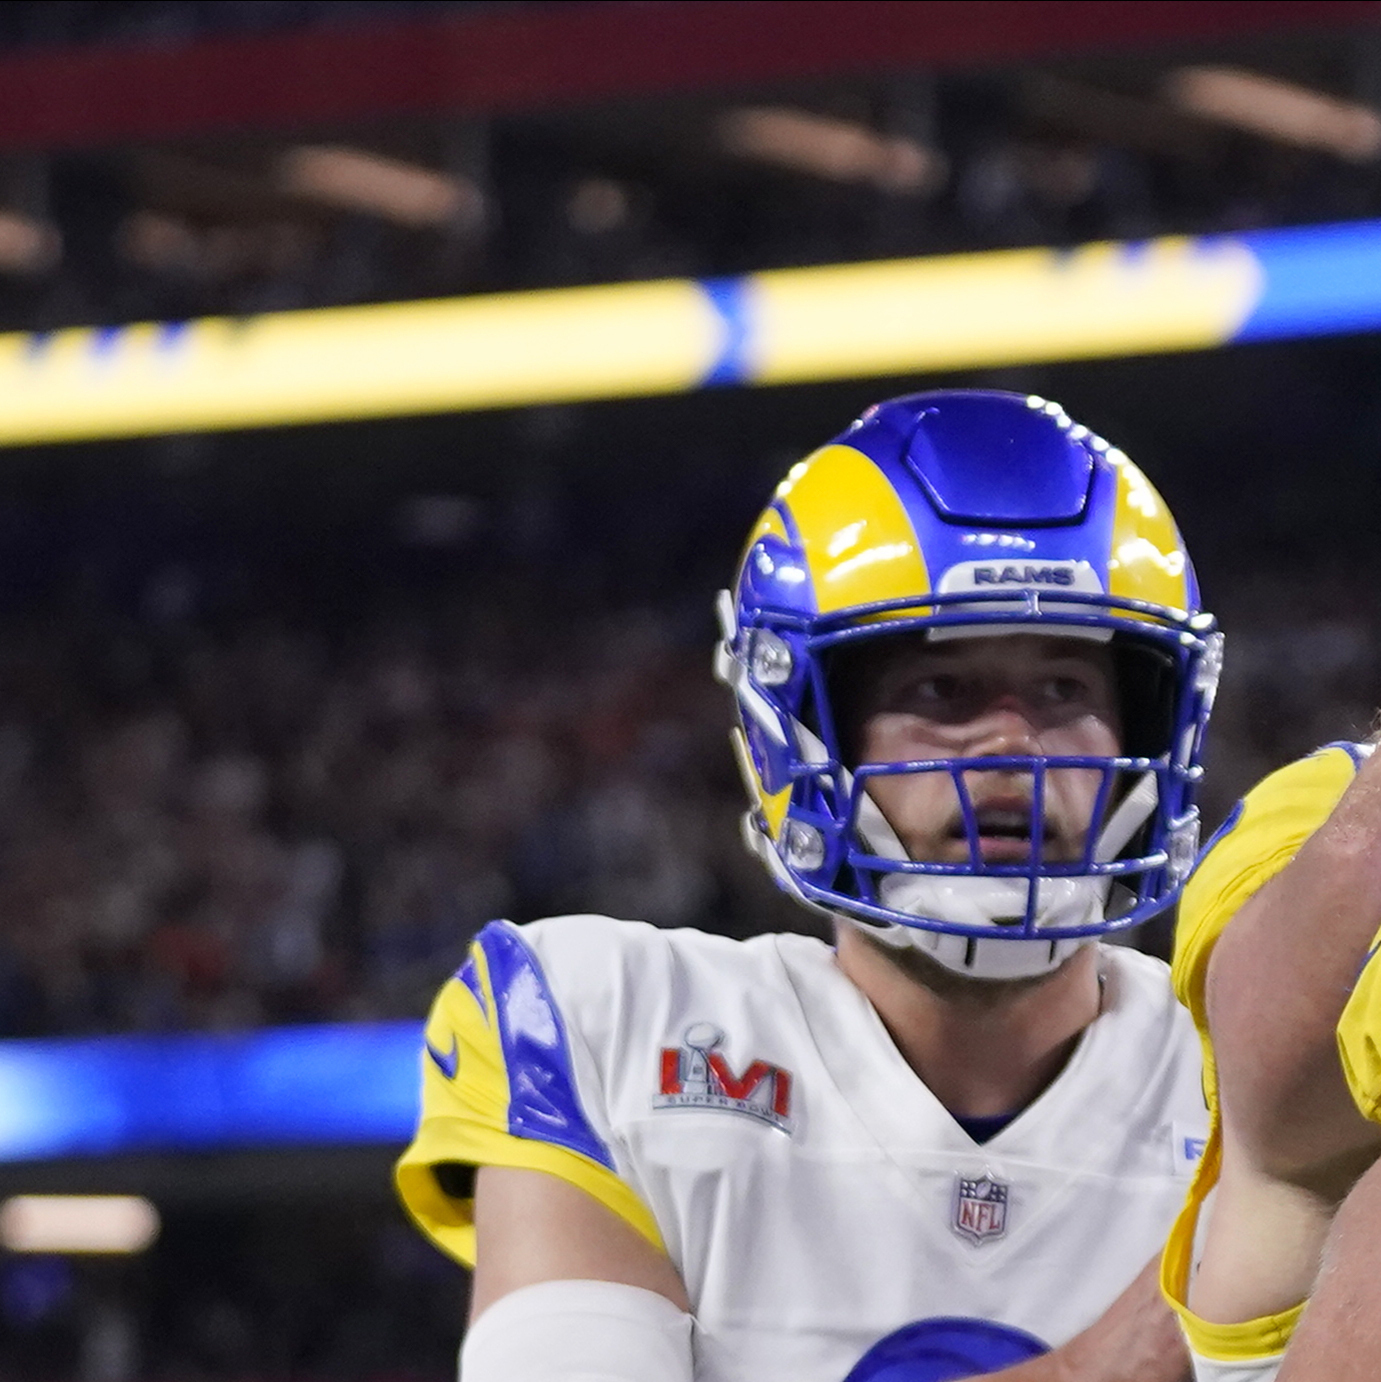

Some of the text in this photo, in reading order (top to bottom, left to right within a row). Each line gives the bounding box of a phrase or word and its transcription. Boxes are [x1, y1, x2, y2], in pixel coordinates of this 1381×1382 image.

[973, 566, 1076, 586] RAMS
[667, 1095, 729, 1106] SUPER
[959, 1202, 1001, 1233] NFL
